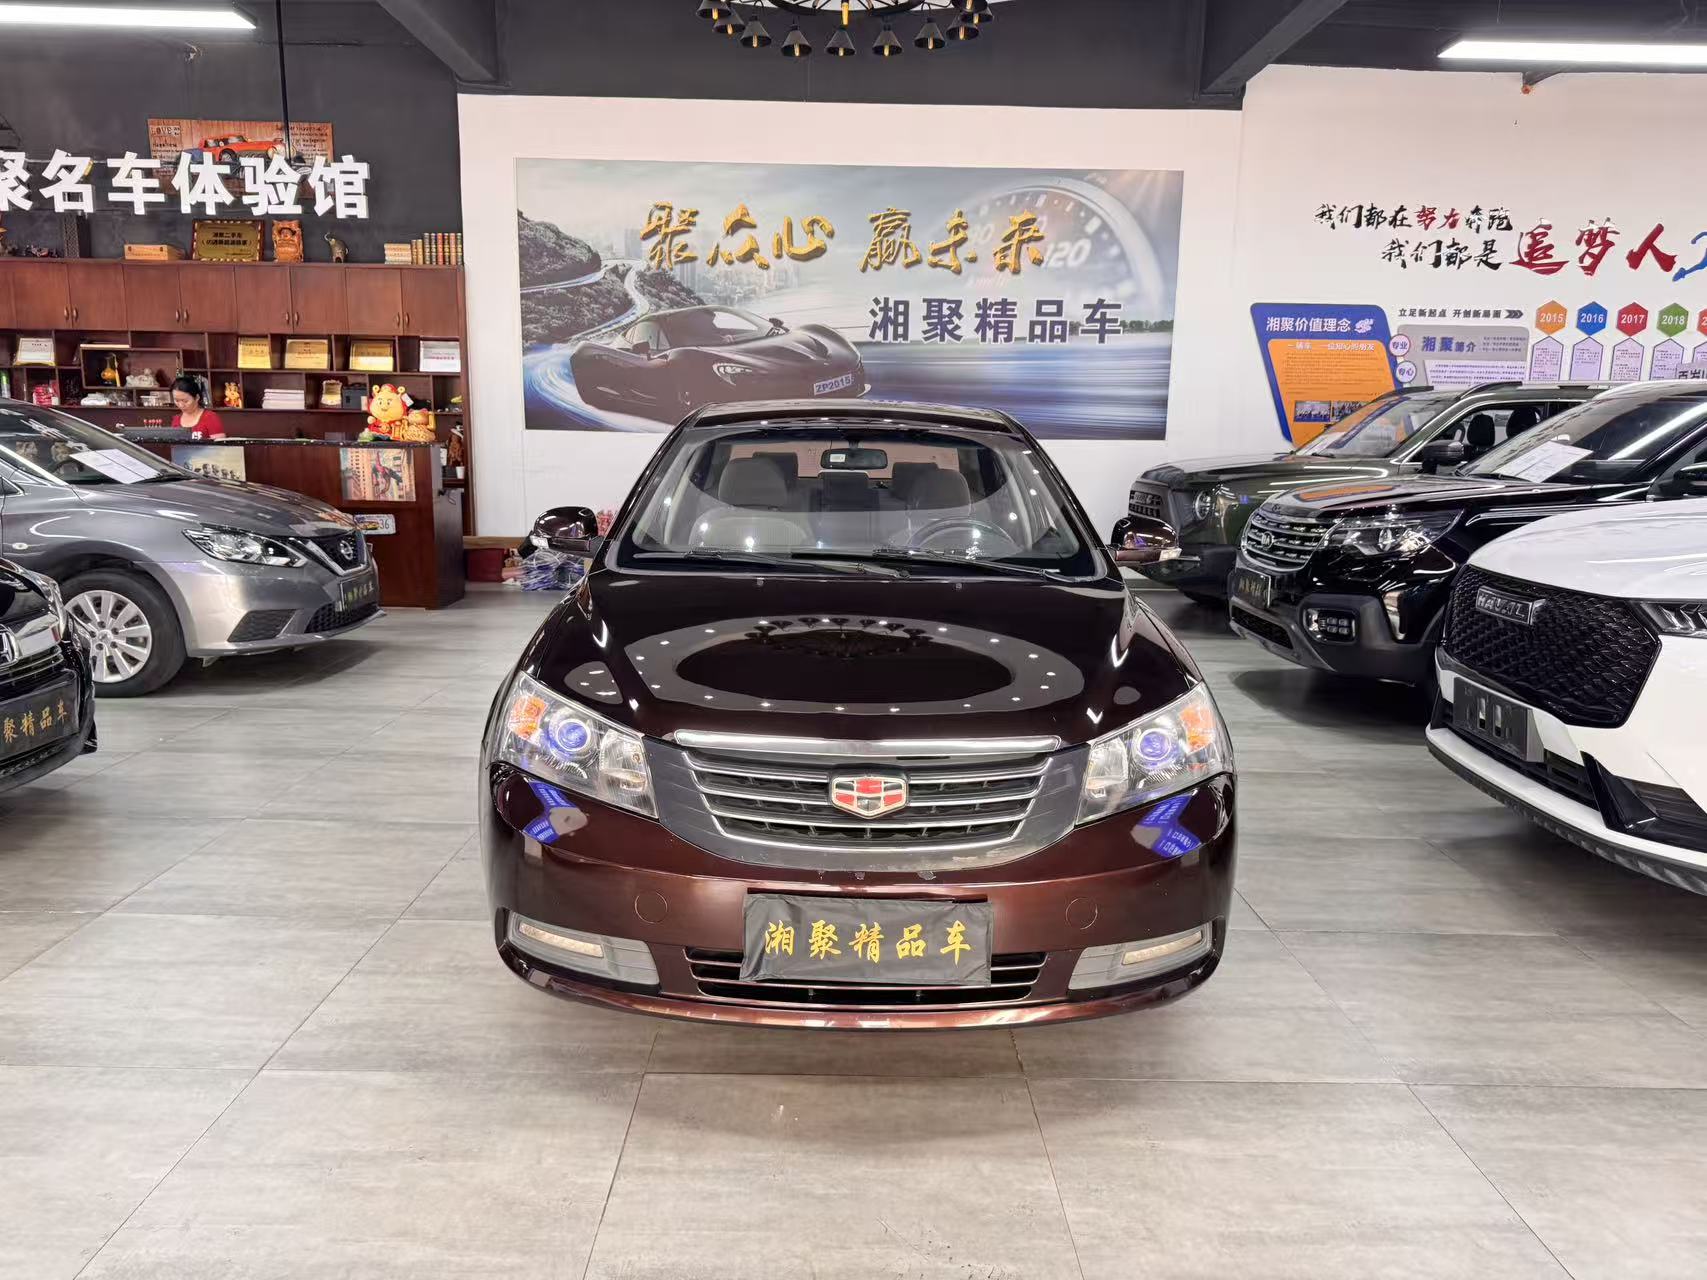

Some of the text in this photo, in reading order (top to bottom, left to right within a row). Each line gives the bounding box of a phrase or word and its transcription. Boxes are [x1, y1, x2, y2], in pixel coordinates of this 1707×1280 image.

[1314, 204, 1513, 234] 我们都在努力奔跑
[639, 200, 1045, 275] 聚众心 赢未来
[868, 297, 1123, 344] 湘聚精品车
[1398, 308, 1447, 318] 立足新起点
[1540, 313, 1564, 323] 2015
[1580, 313, 1604, 324] 2016
[1621, 314, 1645, 324] 2017
[1662, 315, 1685, 325] 2018
[1266, 316, 1351, 332] 湘聚价值理念
[815, 374, 852, 393] ZP2015
[764, 919, 972, 969] 湘聚精品车
